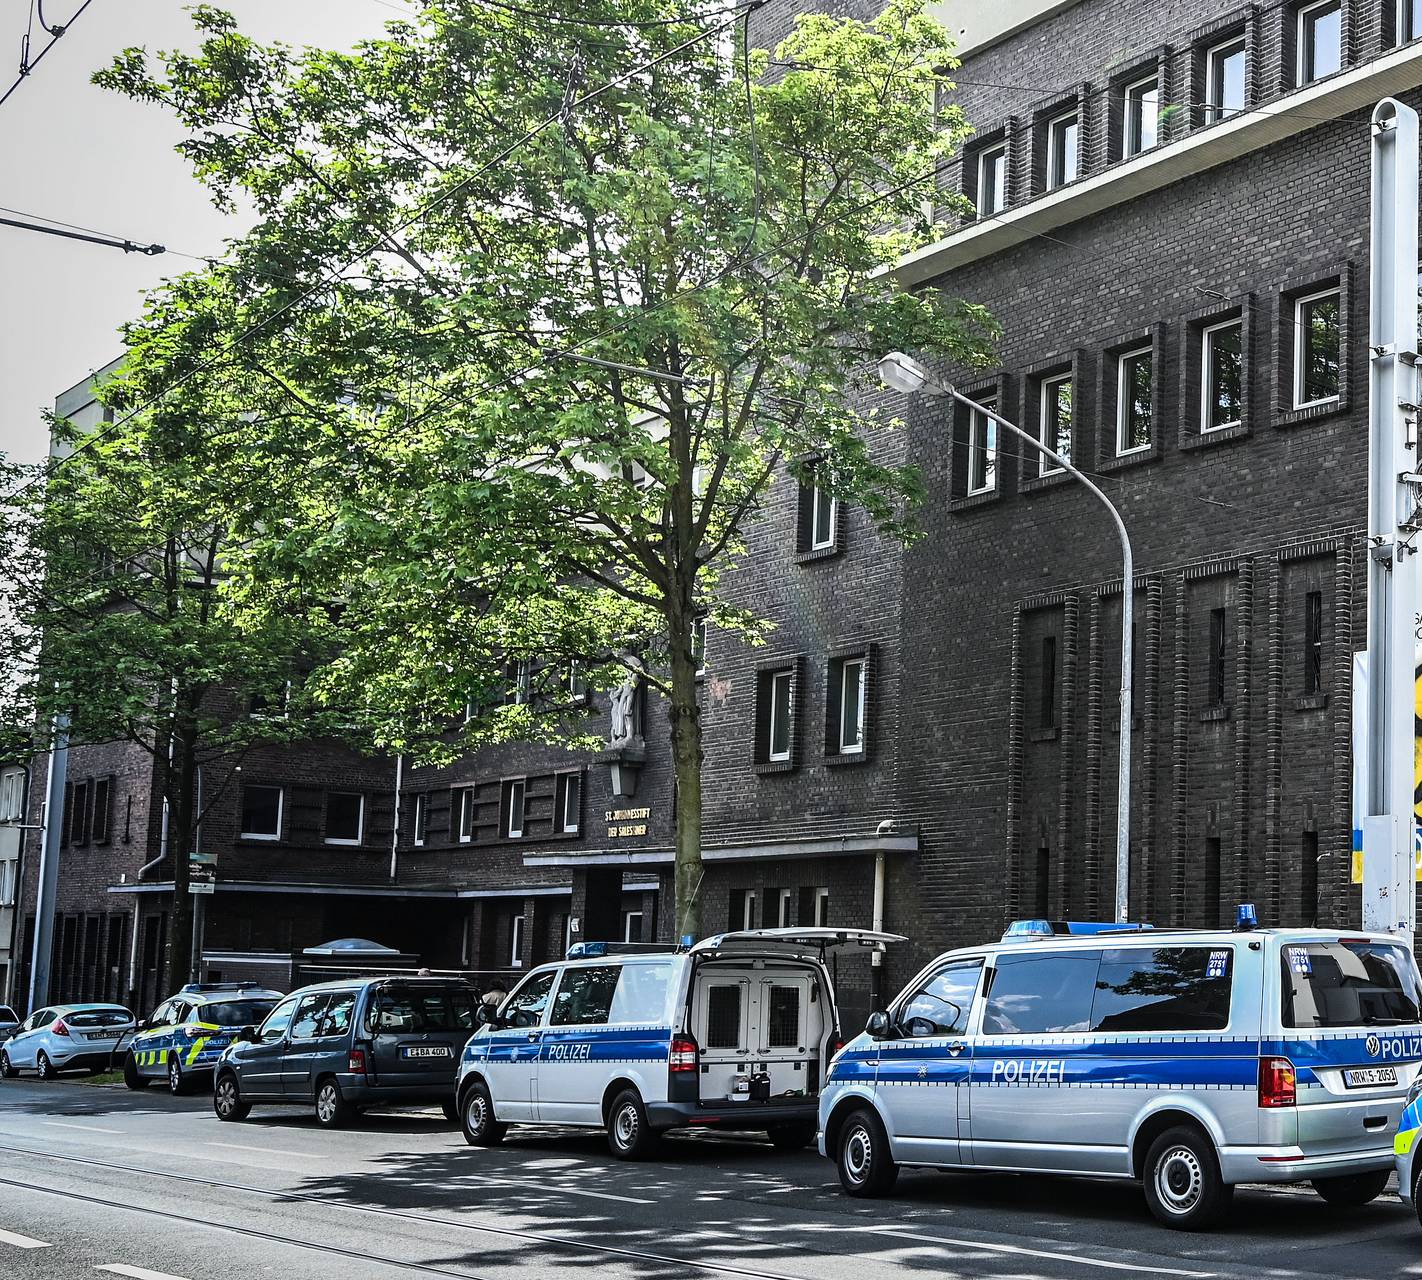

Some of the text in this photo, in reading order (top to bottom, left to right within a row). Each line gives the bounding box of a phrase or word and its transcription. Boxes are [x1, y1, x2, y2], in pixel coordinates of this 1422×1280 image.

[1209, 951, 1229, 960] NRW
[1288, 947, 1308, 957] NRW
[1209, 960, 1226, 968] 2751
[1291, 956, 1309, 965] 2751
[548, 1043, 591, 1060] POLIZEI
[991, 1059, 1066, 1083] POLIZEI
